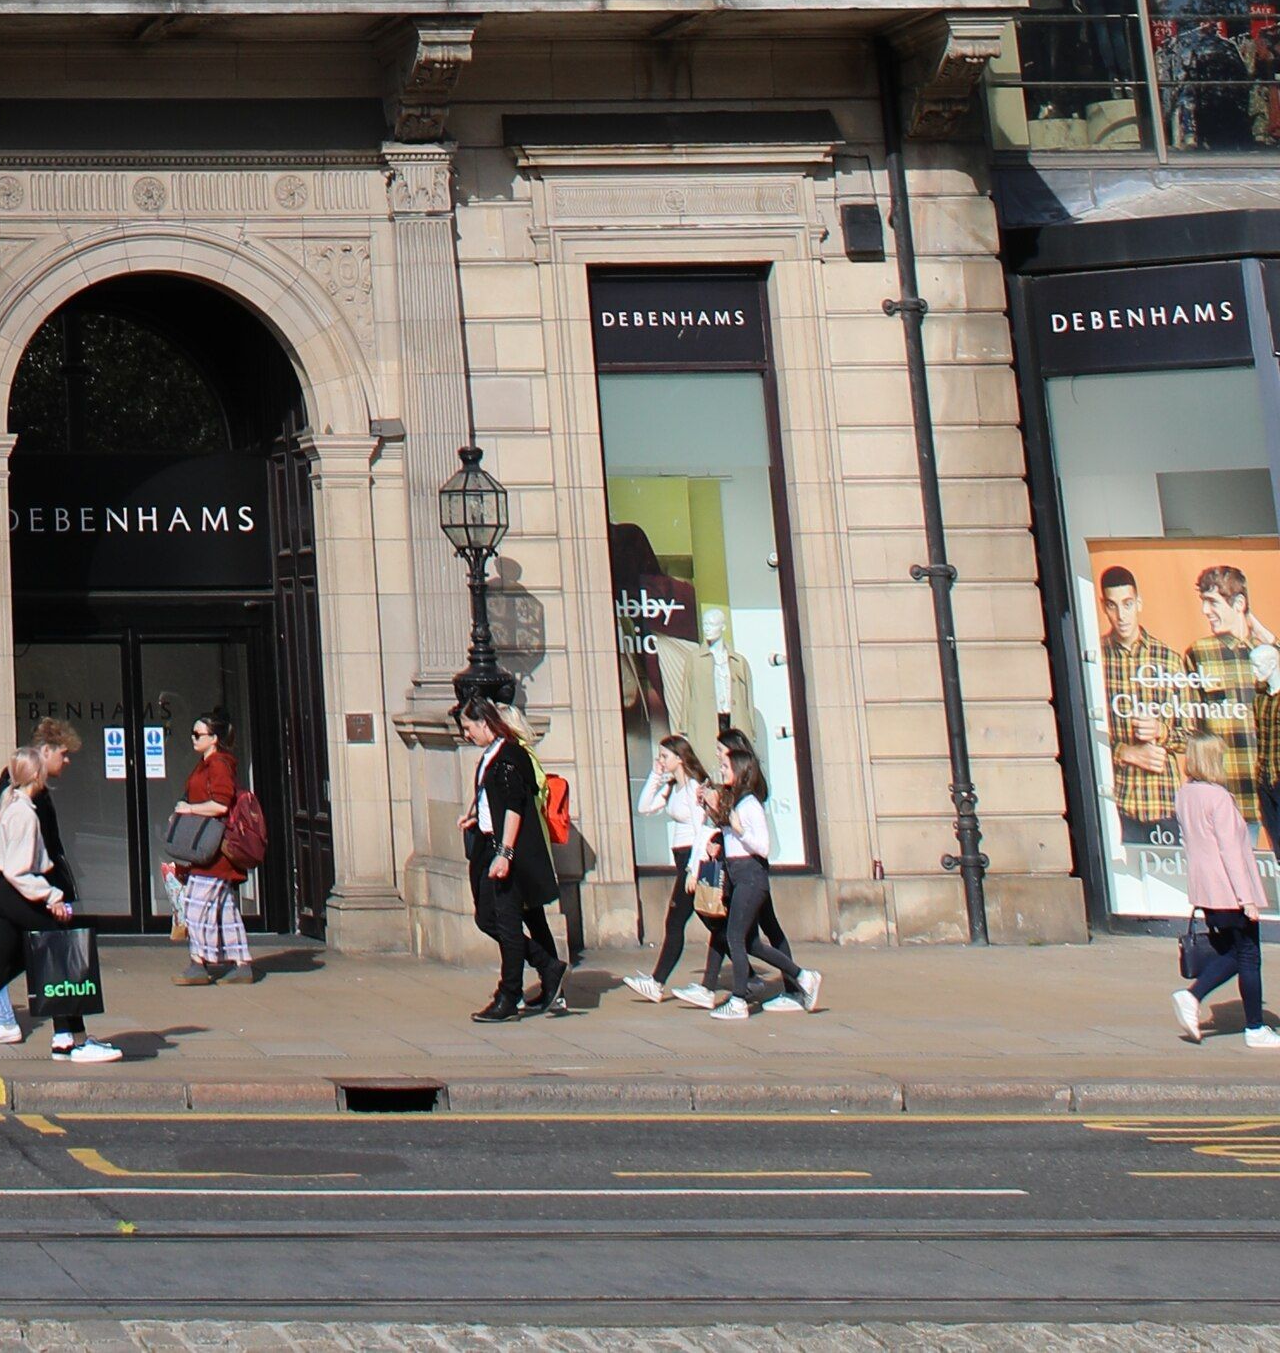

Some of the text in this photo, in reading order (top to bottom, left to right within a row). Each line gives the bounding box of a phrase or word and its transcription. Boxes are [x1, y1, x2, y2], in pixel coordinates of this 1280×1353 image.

[601, 310, 745, 328] DEBENHAMS
[1051, 301, 1234, 334] DEBENHAMS
[616, 589, 675, 626] bby
[618, 626, 658, 654] hic
[1111, 693, 1249, 720] Checkmate
[1149, 824, 1175, 845] do
[44, 979, 96, 998] schuh
